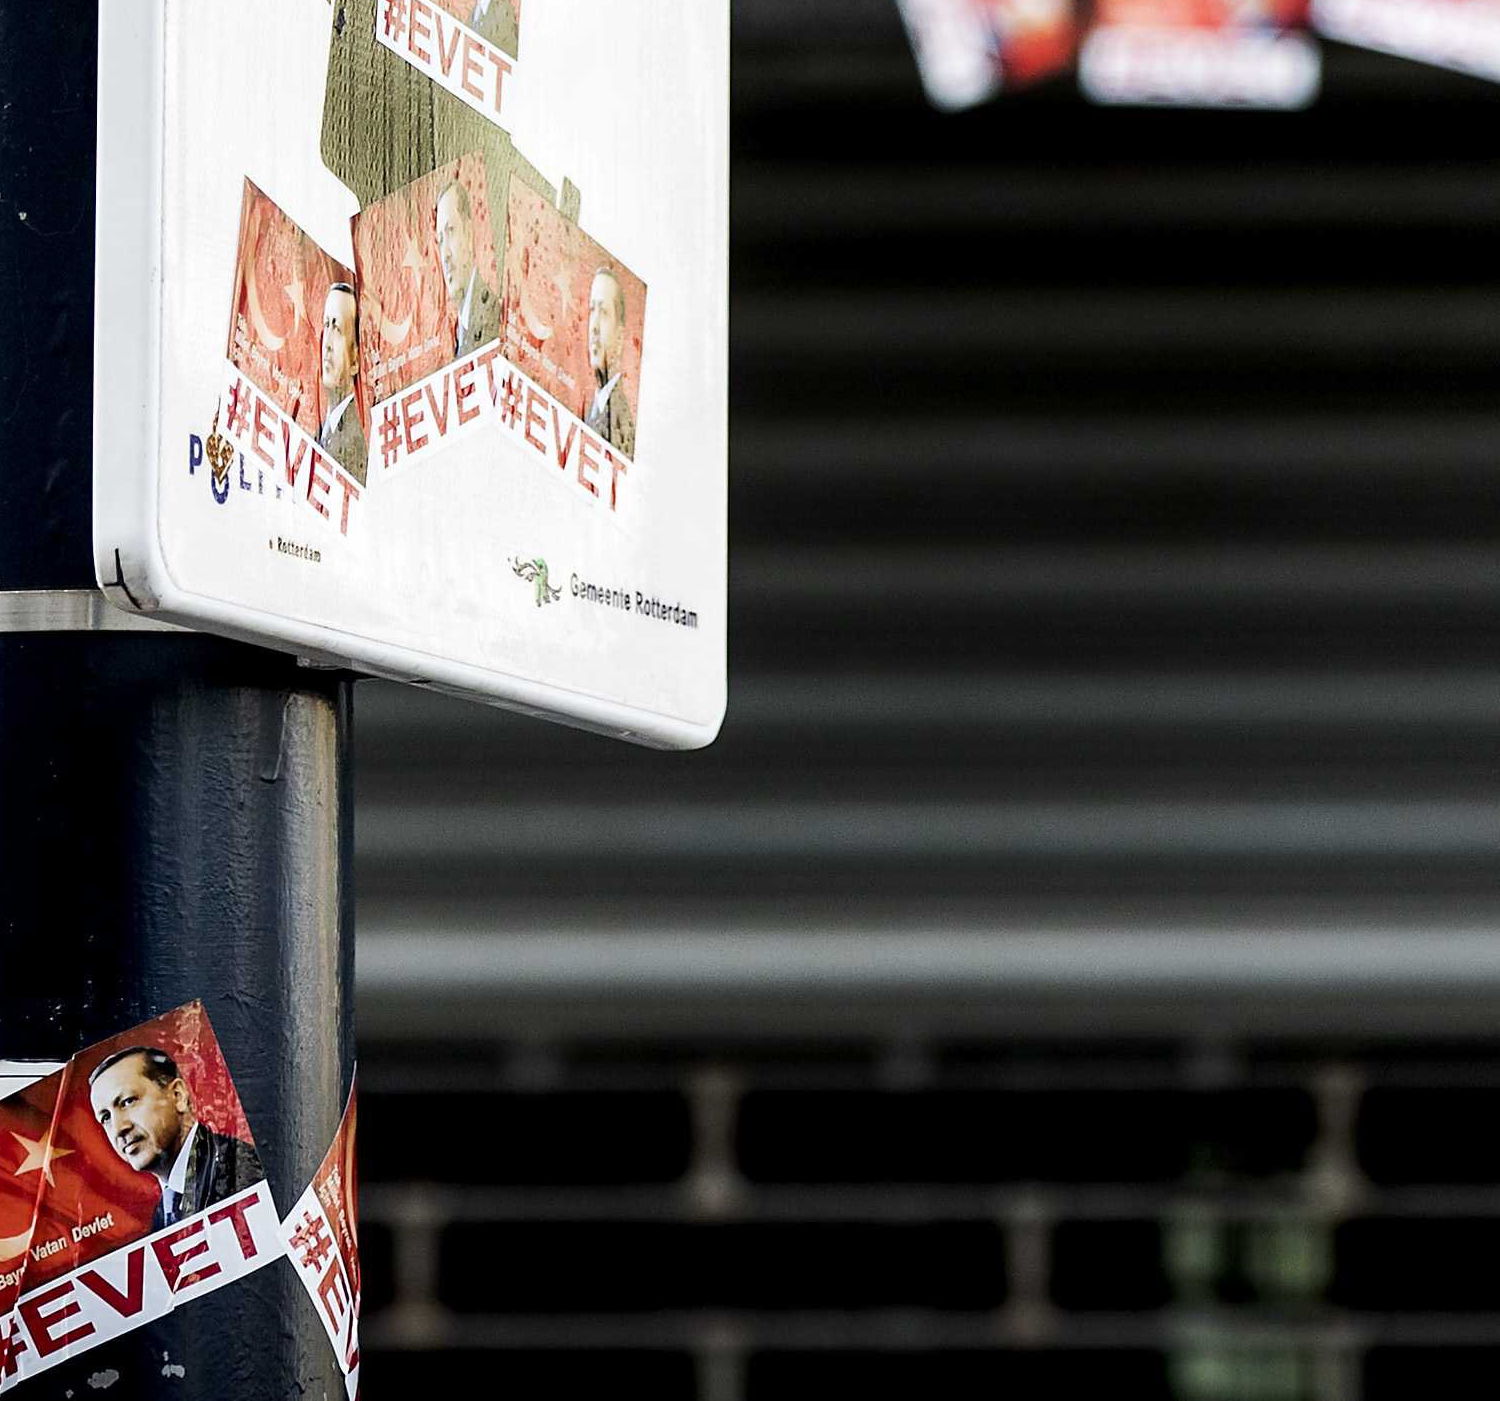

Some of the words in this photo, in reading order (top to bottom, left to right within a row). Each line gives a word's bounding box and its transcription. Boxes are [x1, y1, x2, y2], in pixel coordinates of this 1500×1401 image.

[227, 377, 360, 536] #EVET
[378, 353, 499, 469] #EVET
[501, 371, 627, 512] #EVET
[570, 572, 631, 611] Gemeente
[635, 591, 698, 629] Rotterdam
[31, 1236, 68, 1262] Vatan
[72, 1211, 114, 1243] Devlet
